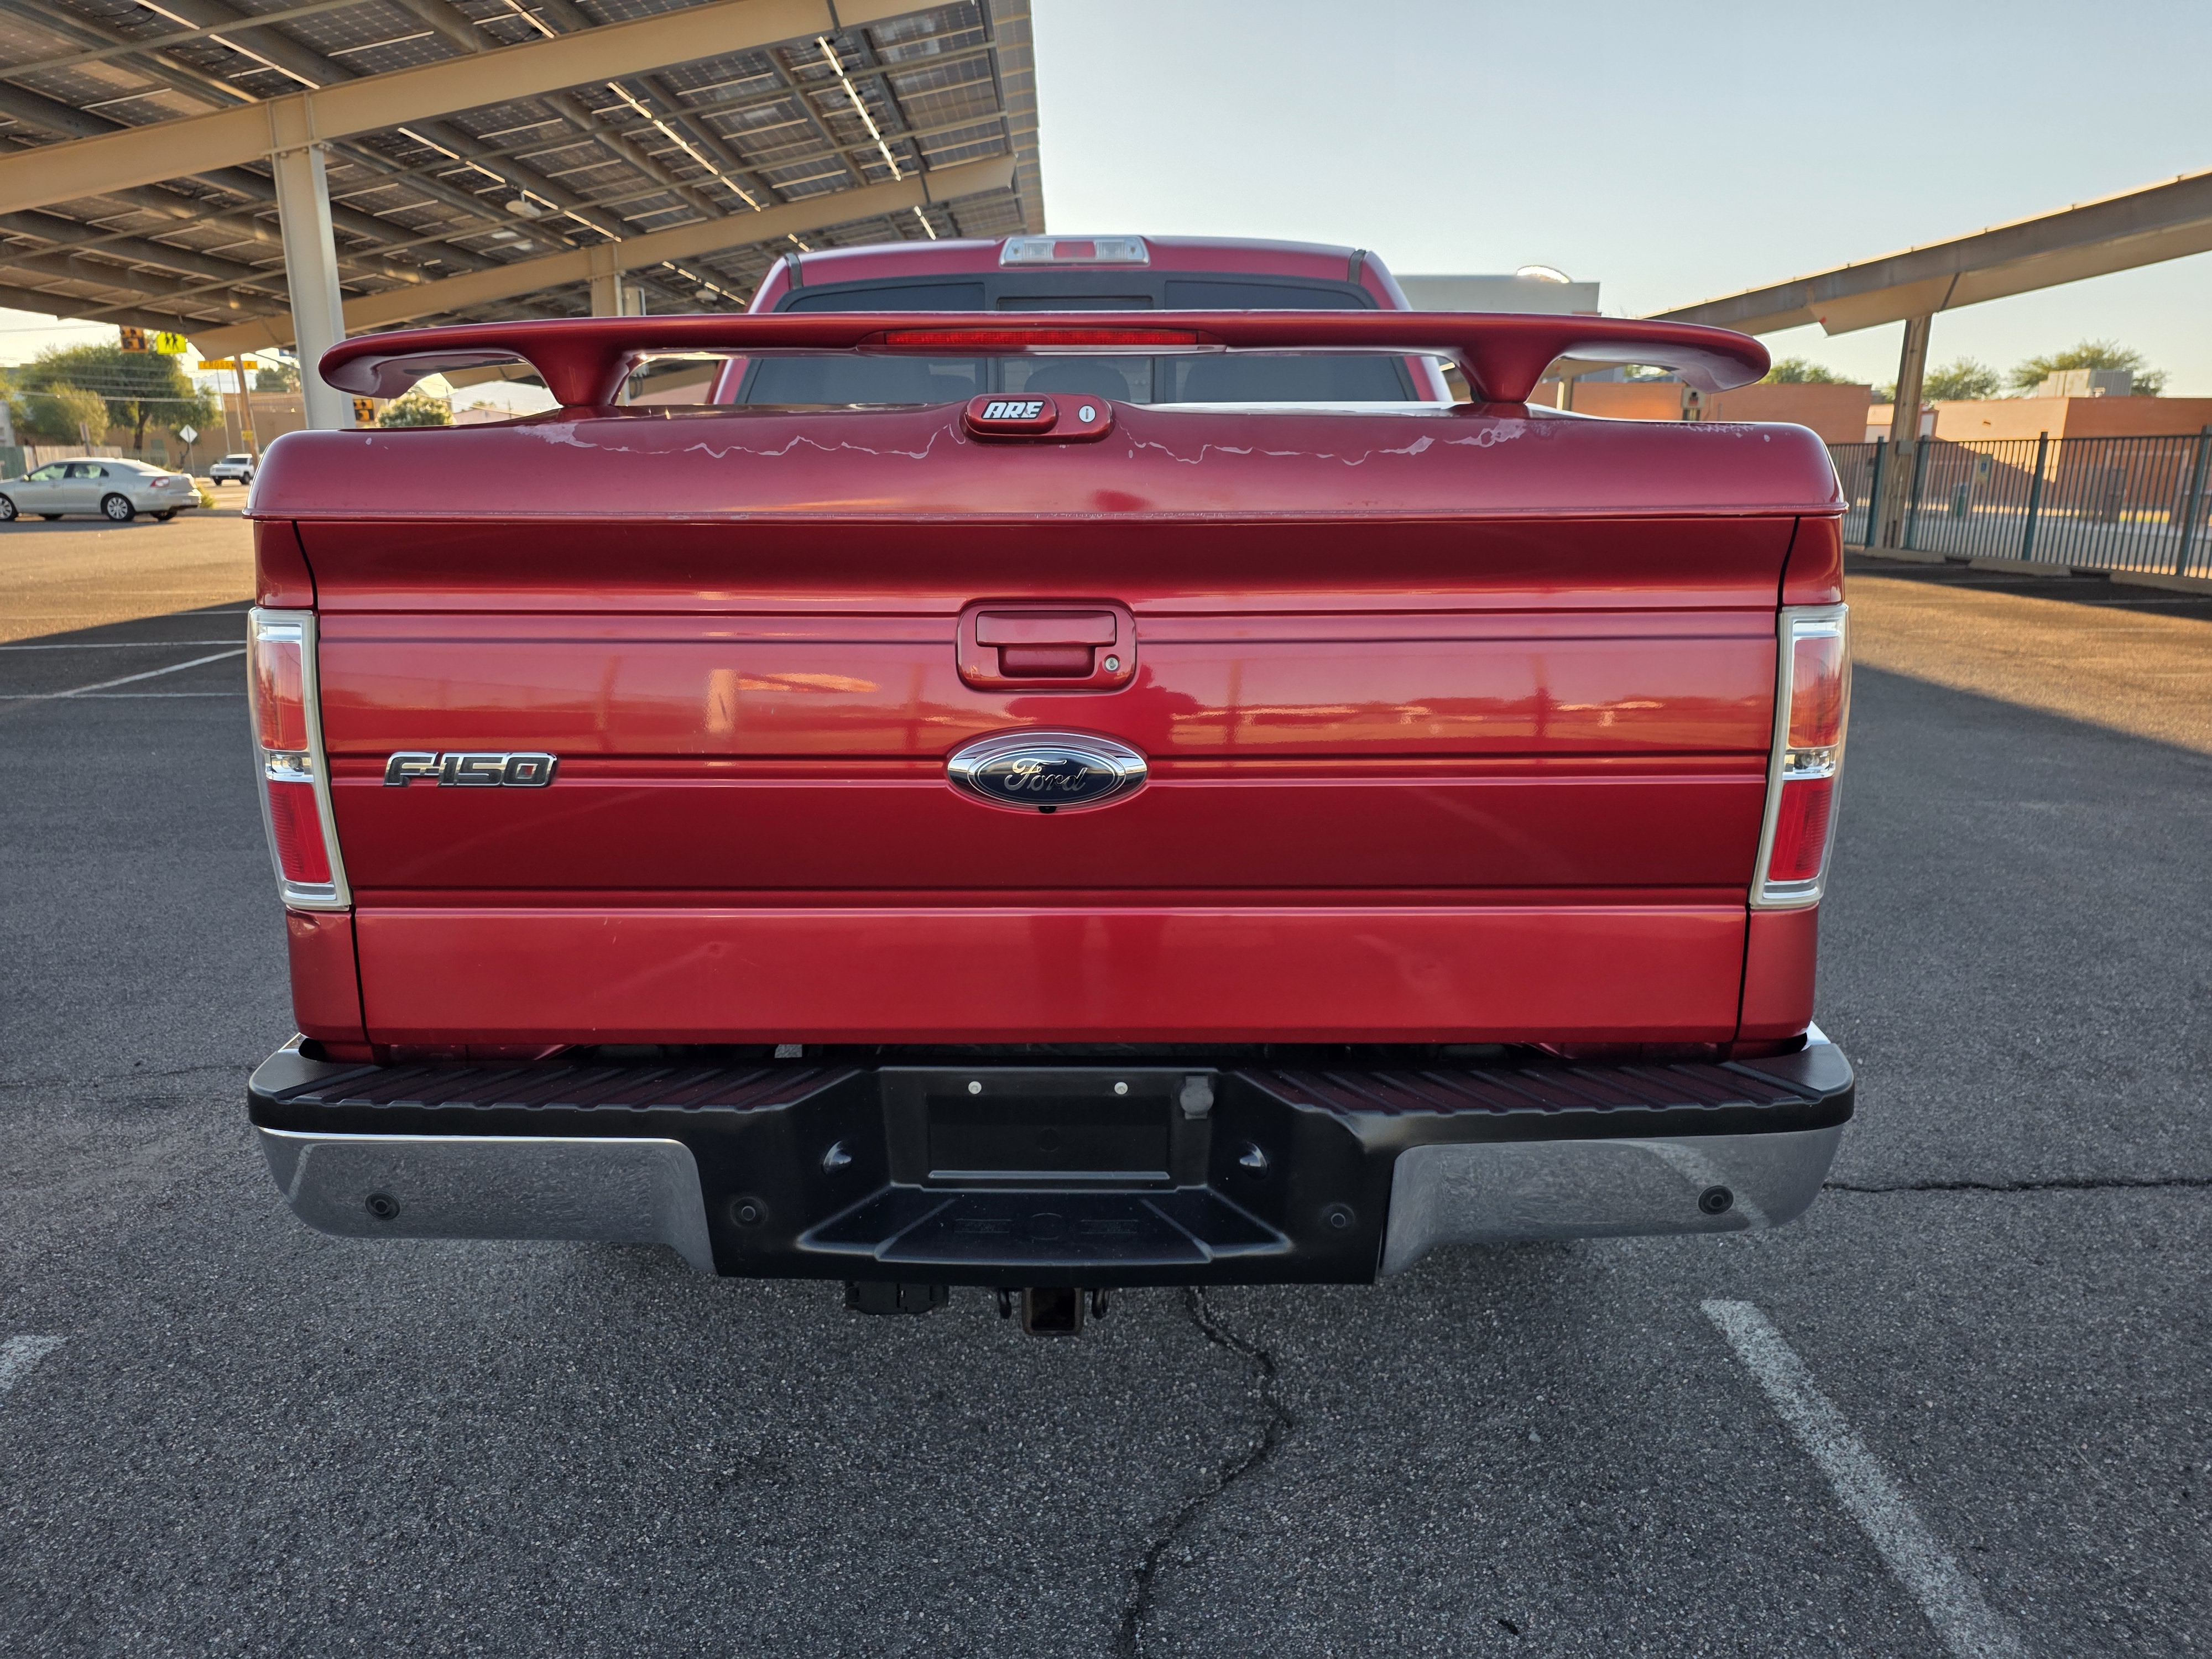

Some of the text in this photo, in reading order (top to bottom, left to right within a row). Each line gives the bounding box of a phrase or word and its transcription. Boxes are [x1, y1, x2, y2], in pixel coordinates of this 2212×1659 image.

[983, 402, 1044, 418] ARE
[384, 752, 557, 787] F-150
[1004, 758, 1088, 791] Ford
